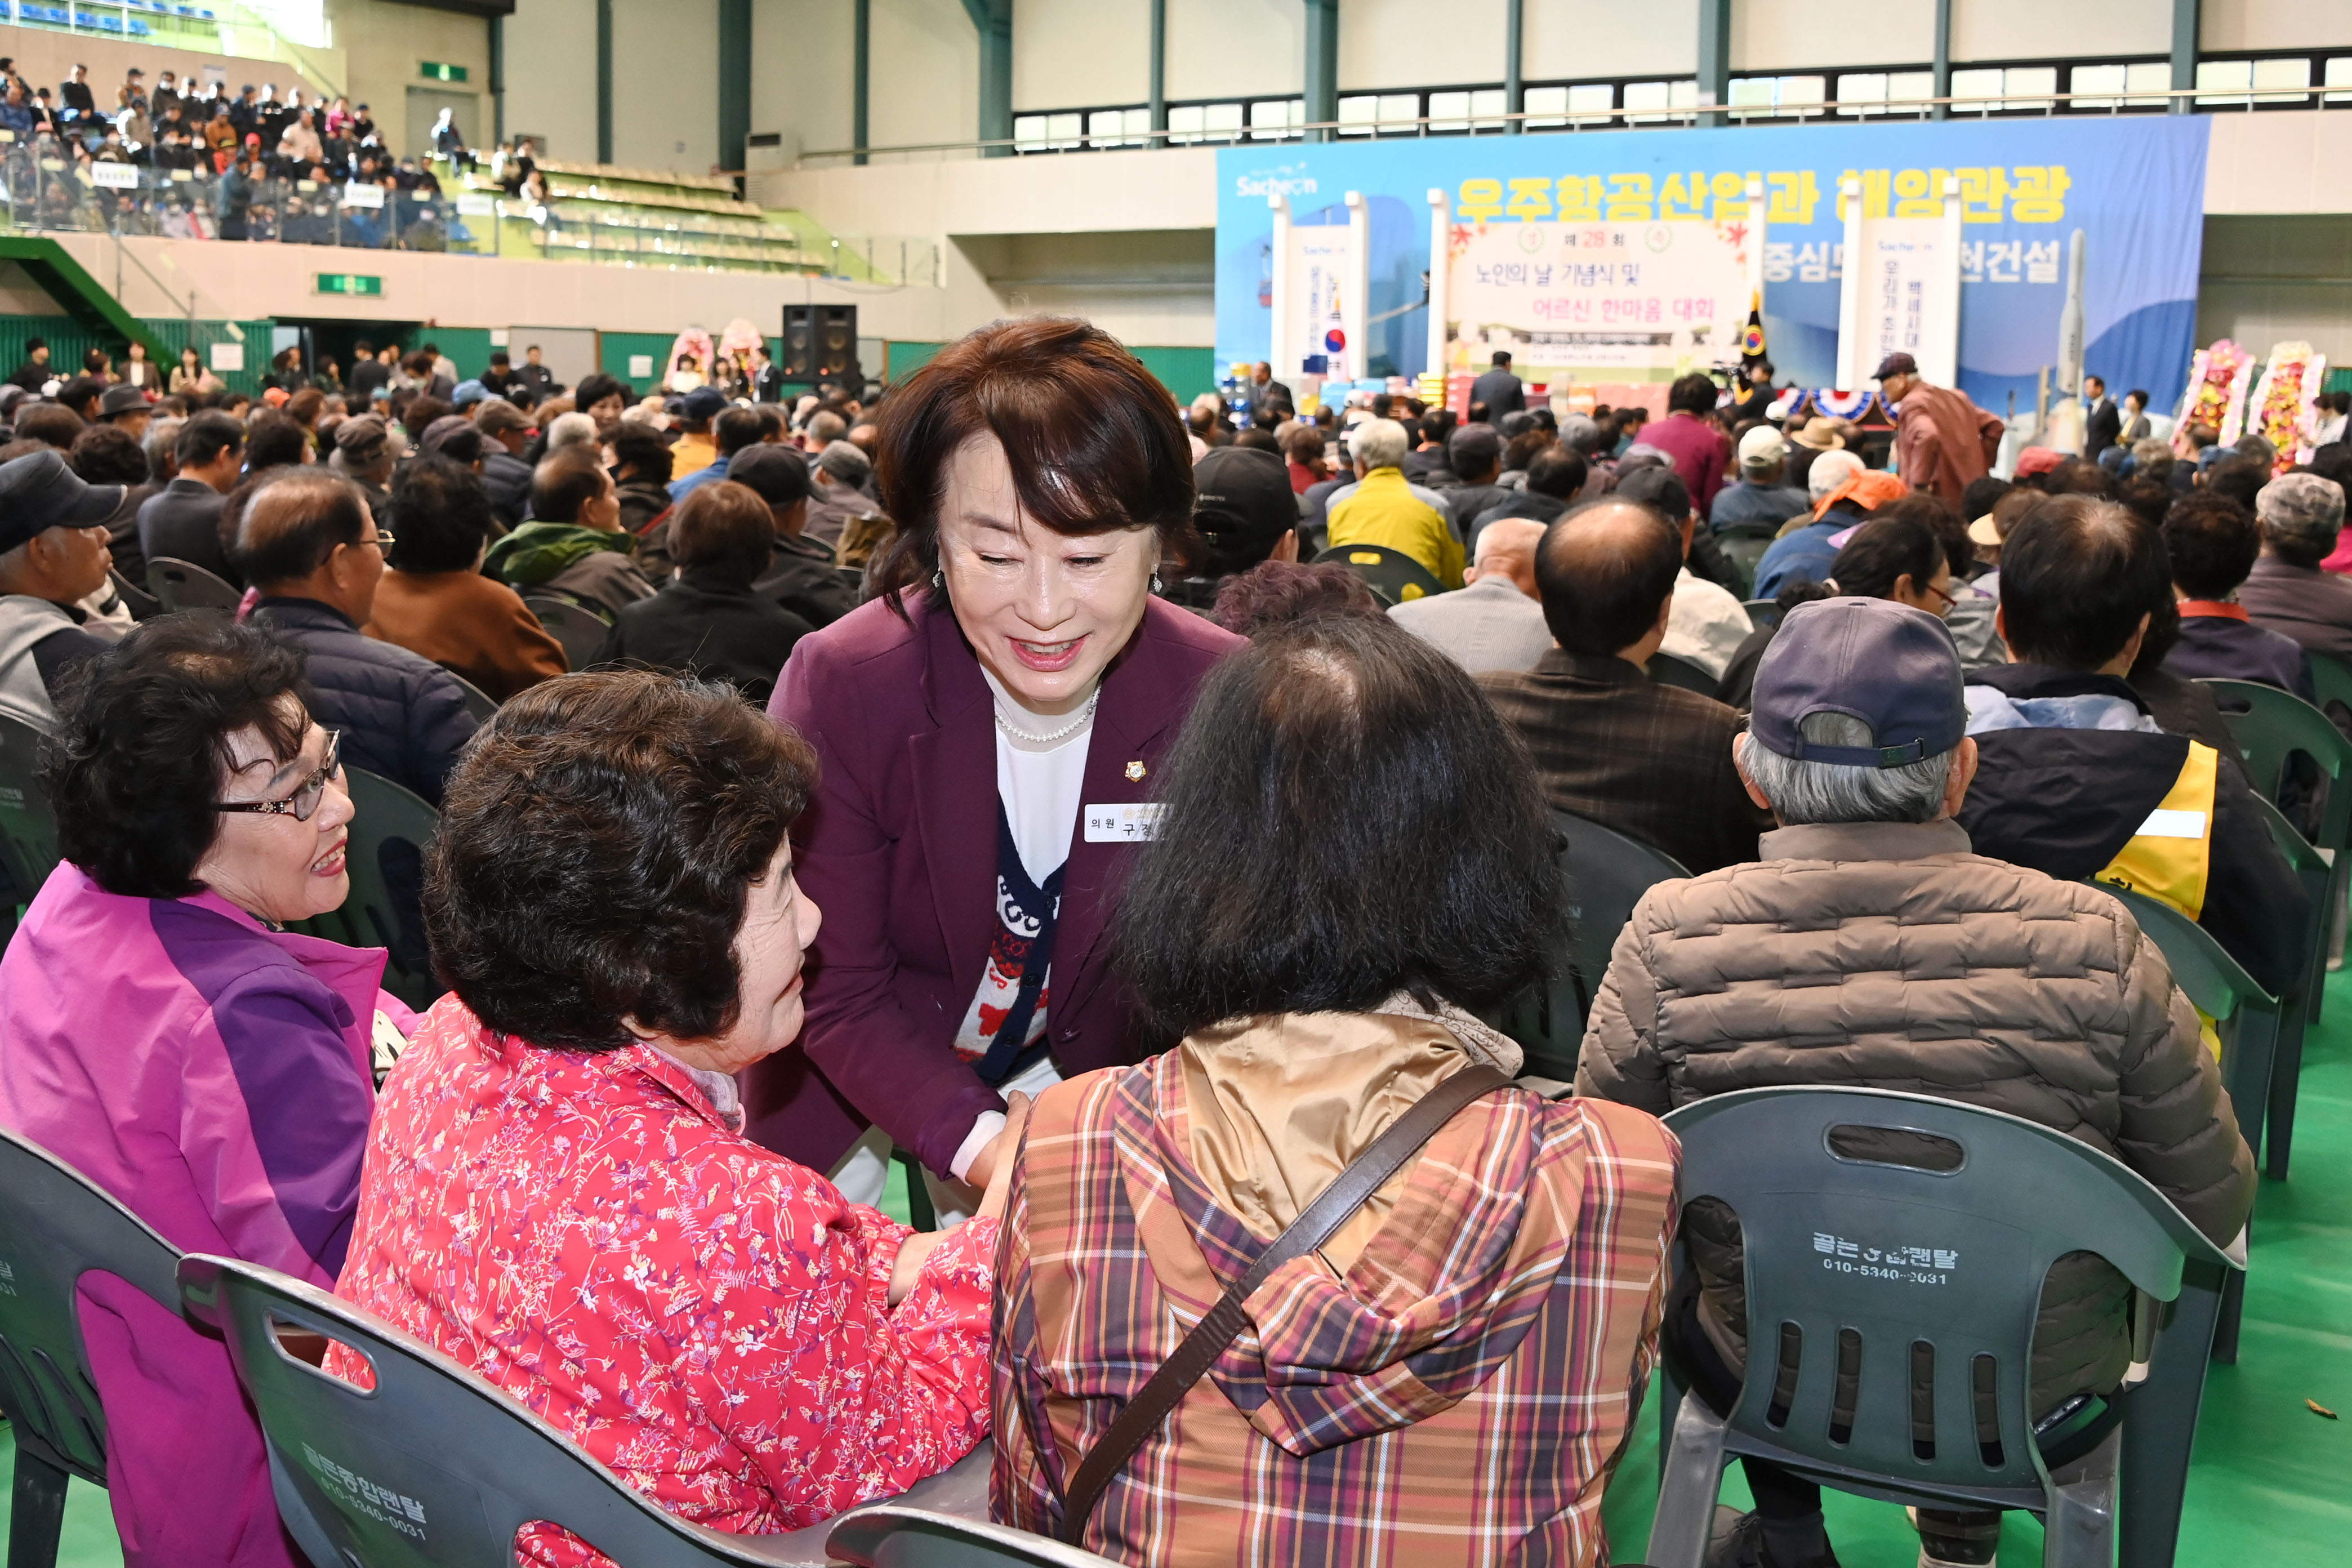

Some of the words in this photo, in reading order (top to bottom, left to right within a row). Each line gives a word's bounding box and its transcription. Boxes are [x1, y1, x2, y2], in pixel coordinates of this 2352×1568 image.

[1458, 170, 1820, 224] 우주항공산업과
[1836, 166, 2072, 224] 해양관광
[1582, 230, 1606, 248] 28
[1476, 263, 1527, 286] 노인의
[1534, 263, 1553, 286] 날
[1561, 263, 1615, 287] 기념식
[1622, 263, 1641, 286] 및
[1533, 297, 1591, 322] 어르신
[1601, 297, 1662, 322] 한마음
[1673, 297, 1714, 321] 대회
[321, 1476, 426, 1540] 010-5340-0031
